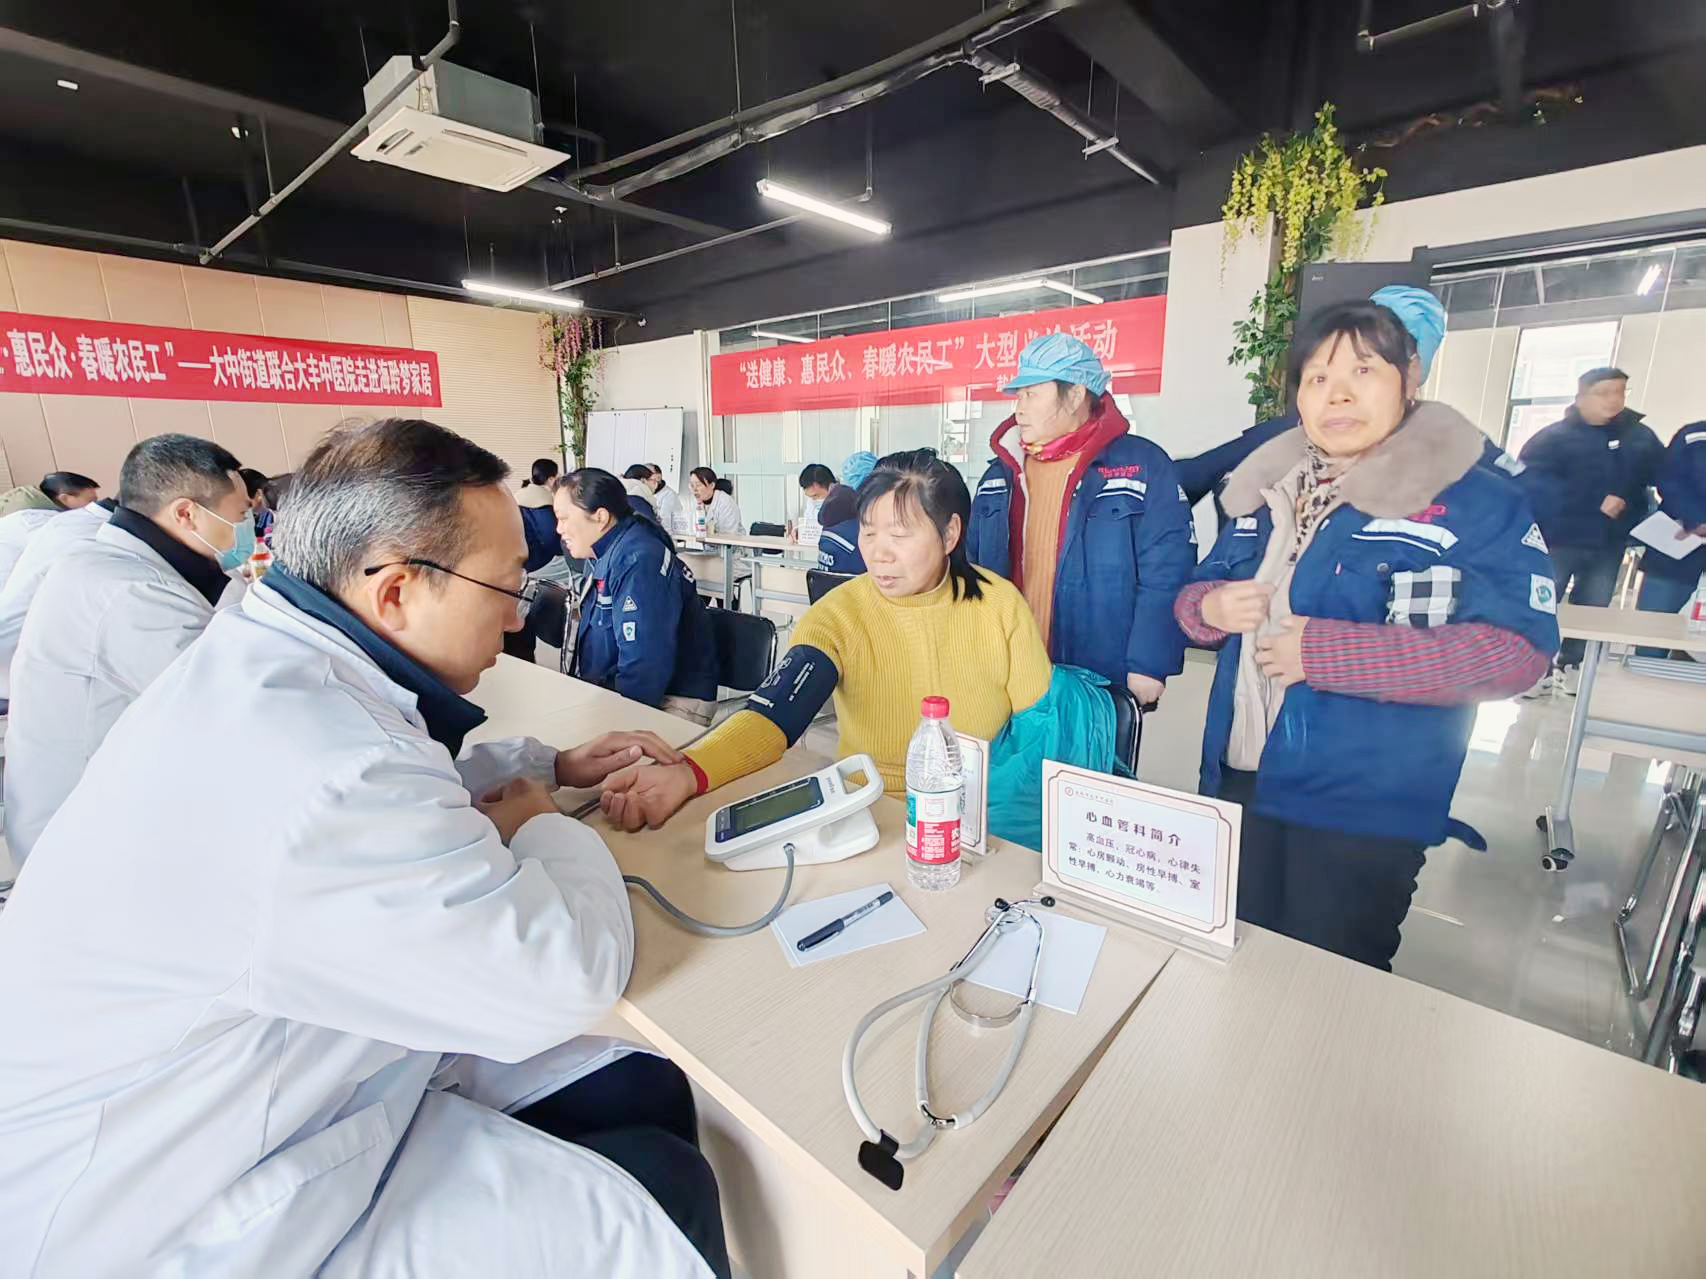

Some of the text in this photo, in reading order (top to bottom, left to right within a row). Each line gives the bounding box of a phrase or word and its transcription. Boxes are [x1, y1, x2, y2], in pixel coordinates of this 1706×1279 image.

[739, 319, 1118, 389] “送健康、惠民众、春暖农民工”大型活动
[1086, 811, 1181, 847] 心血管科简介
